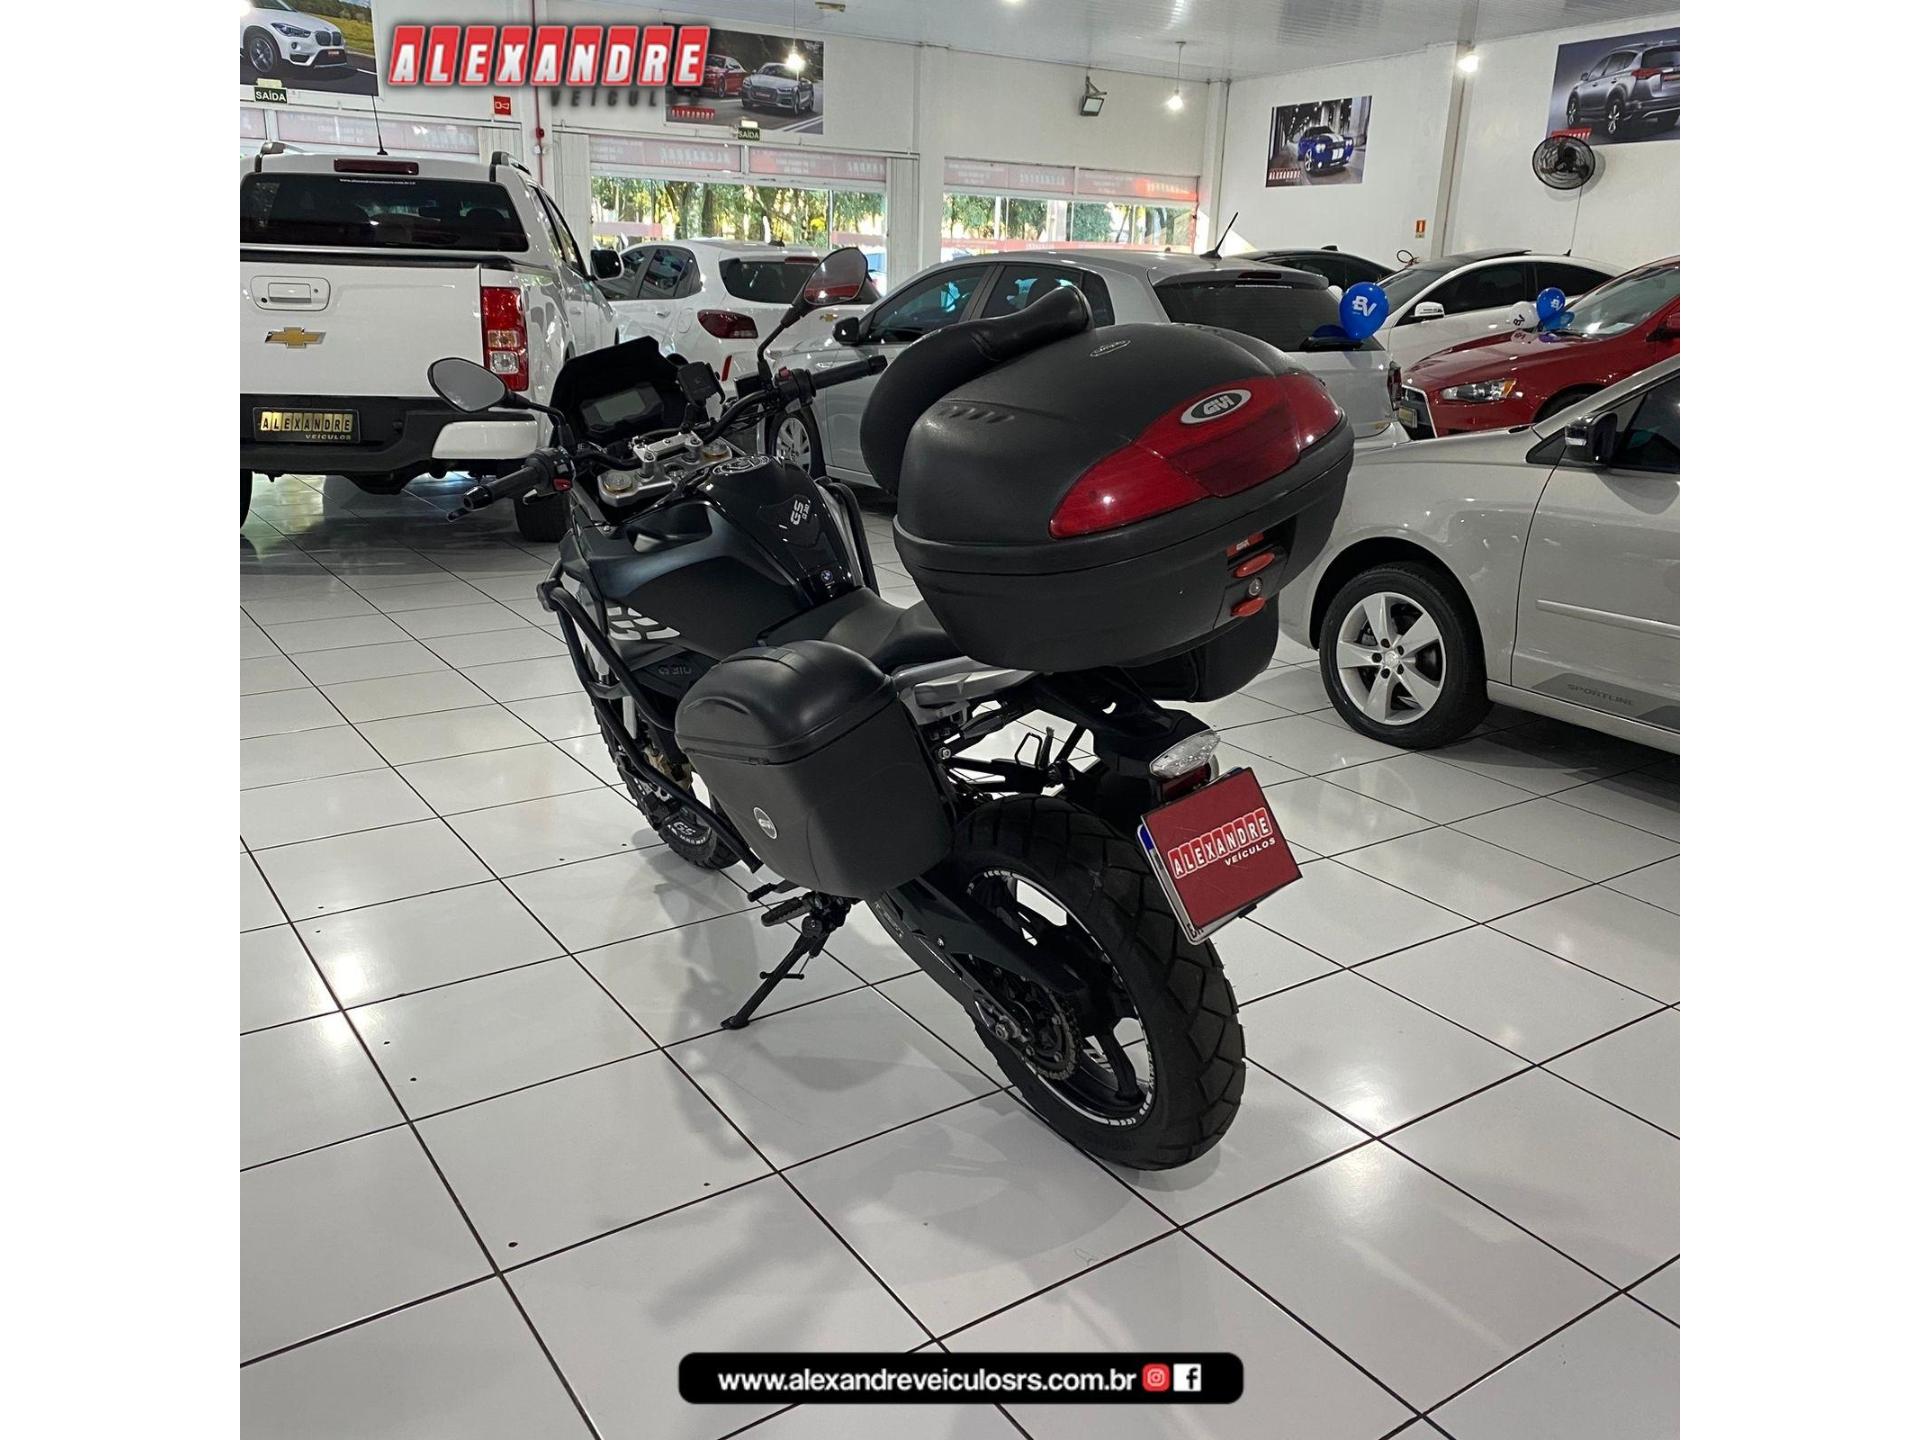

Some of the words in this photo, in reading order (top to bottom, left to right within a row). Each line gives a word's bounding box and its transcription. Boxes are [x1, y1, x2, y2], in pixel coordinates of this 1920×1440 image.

[255, 90, 287, 102] SAÍDA
[261, 418, 351, 430] ALEXANDRE
[1172, 815, 1271, 877] ALEXANDRE
[1224, 837, 1277, 867] VEÍCULOS
